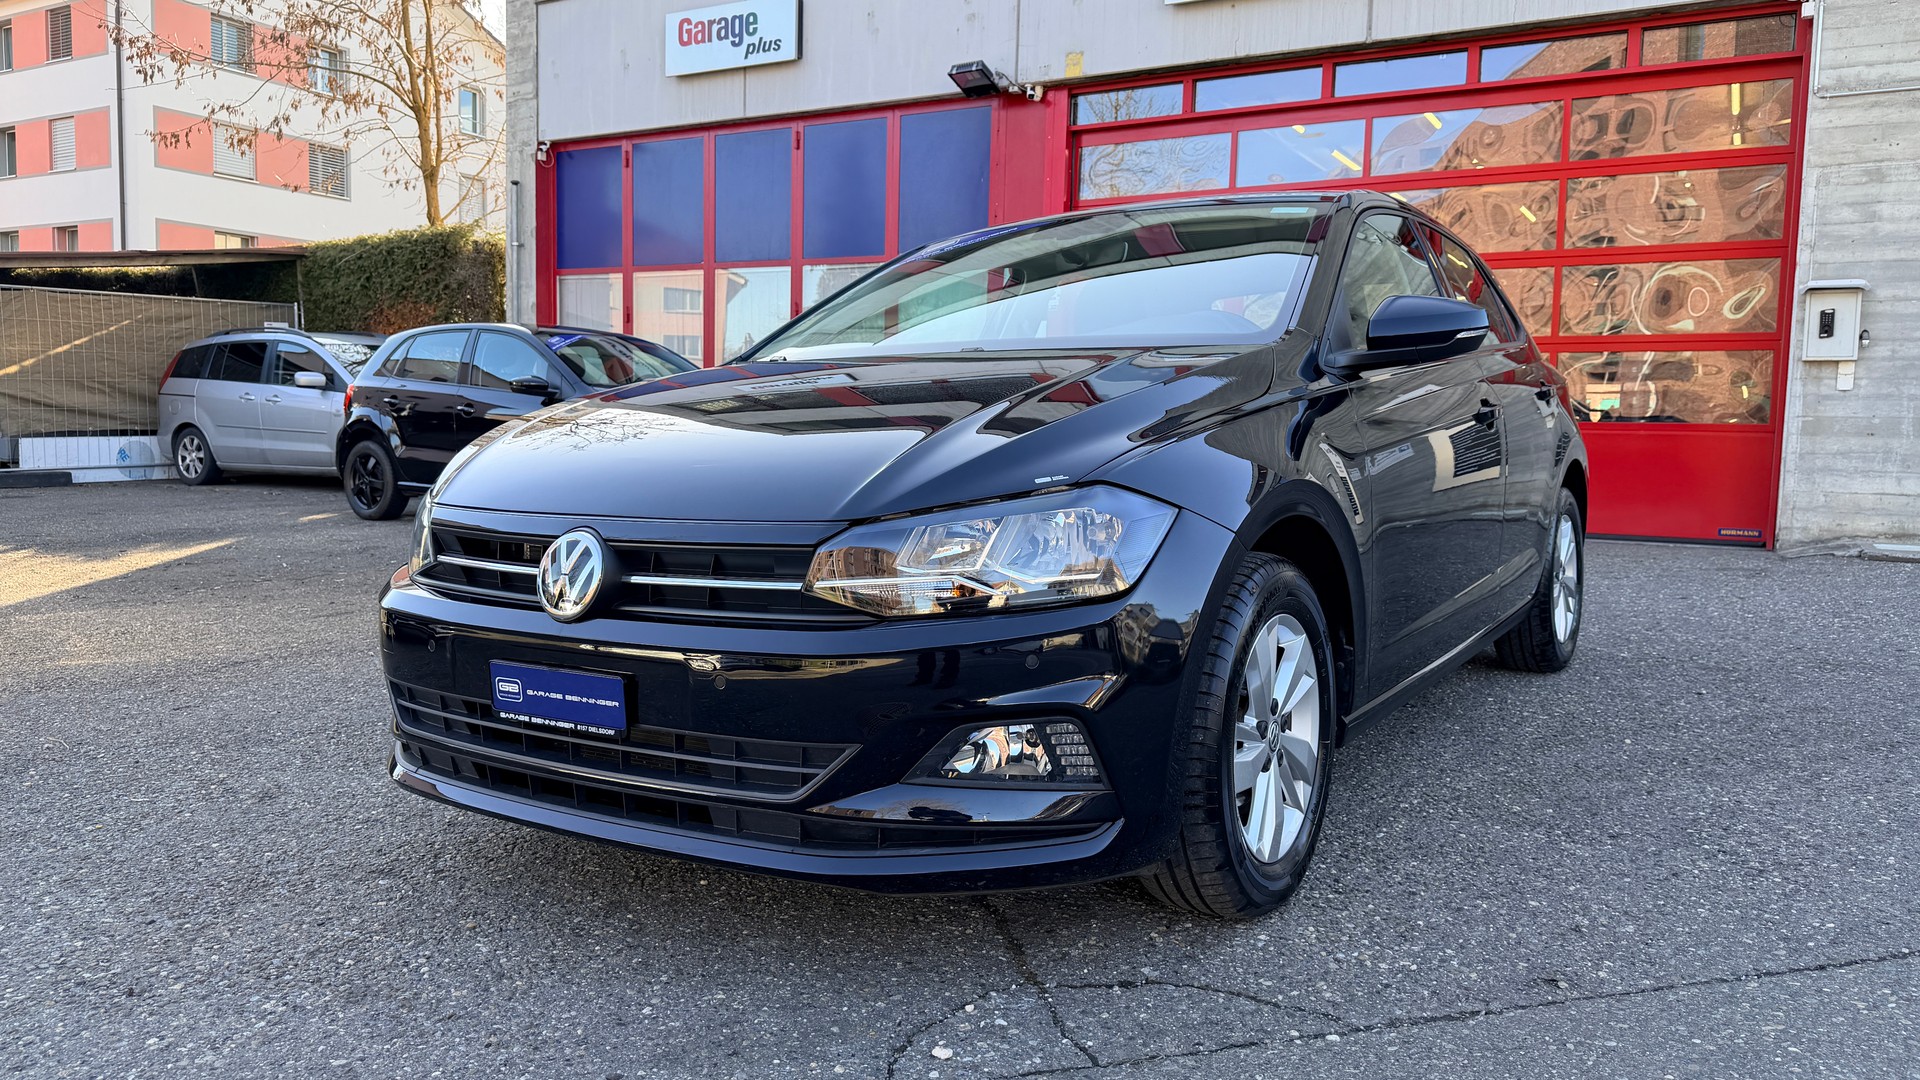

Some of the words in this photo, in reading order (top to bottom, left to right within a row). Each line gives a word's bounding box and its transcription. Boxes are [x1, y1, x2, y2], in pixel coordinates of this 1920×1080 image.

[678, 12, 758, 47] Garage
[744, 37, 782, 59] plus
[526, 689, 563, 700] GARAGE
[565, 694, 619, 707] BENNINGER
[500, 712, 530, 722] GARAGE
[531, 716, 575, 729] BENNINGER
